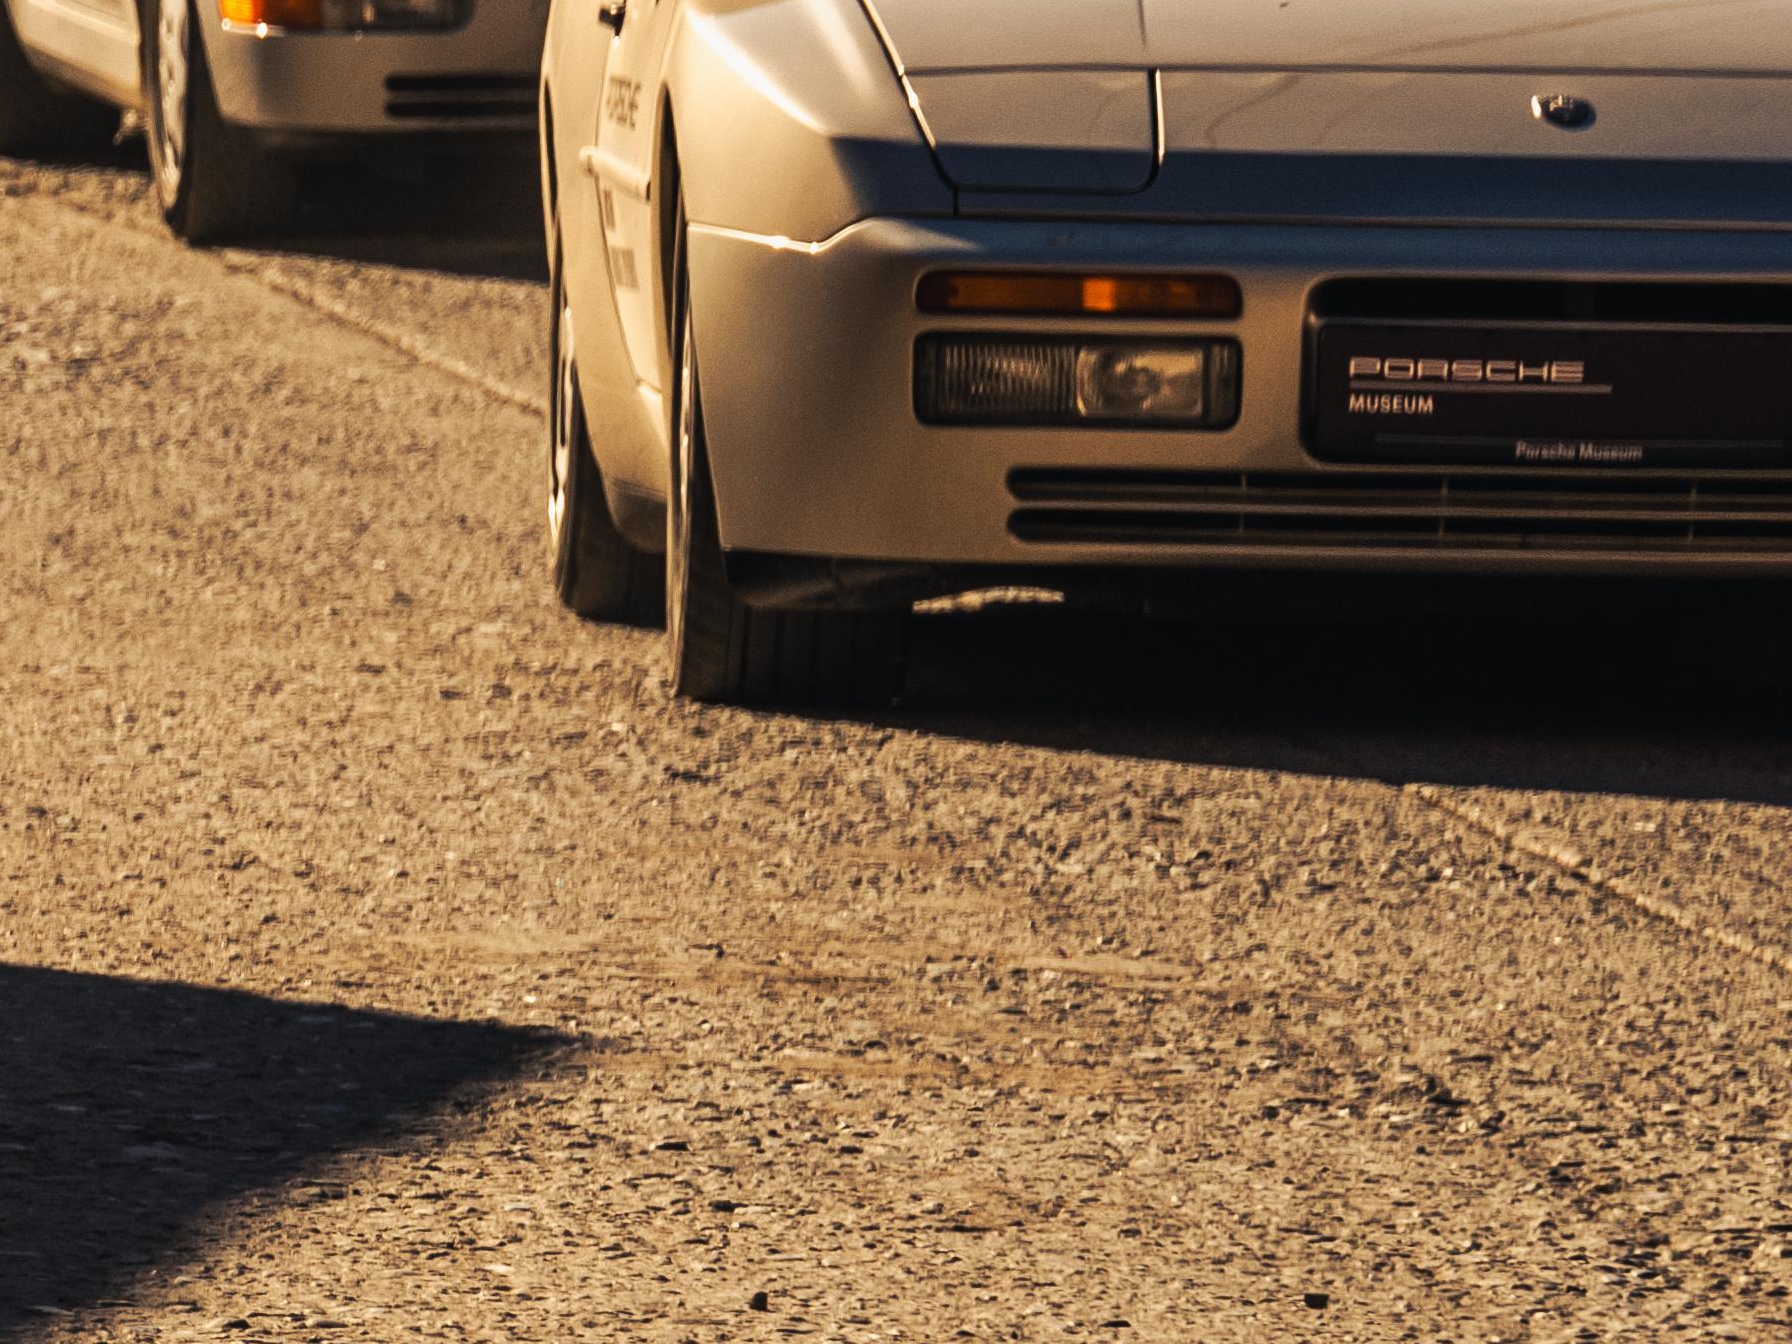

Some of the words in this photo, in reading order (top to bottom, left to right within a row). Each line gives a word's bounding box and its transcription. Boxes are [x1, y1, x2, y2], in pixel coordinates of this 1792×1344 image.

[1349, 356, 1584, 383] PORSCHE
[1349, 392, 1434, 415] MUSEUM
[1515, 441, 1576, 461] Porsche
[1579, 443, 1643, 463] Museum
